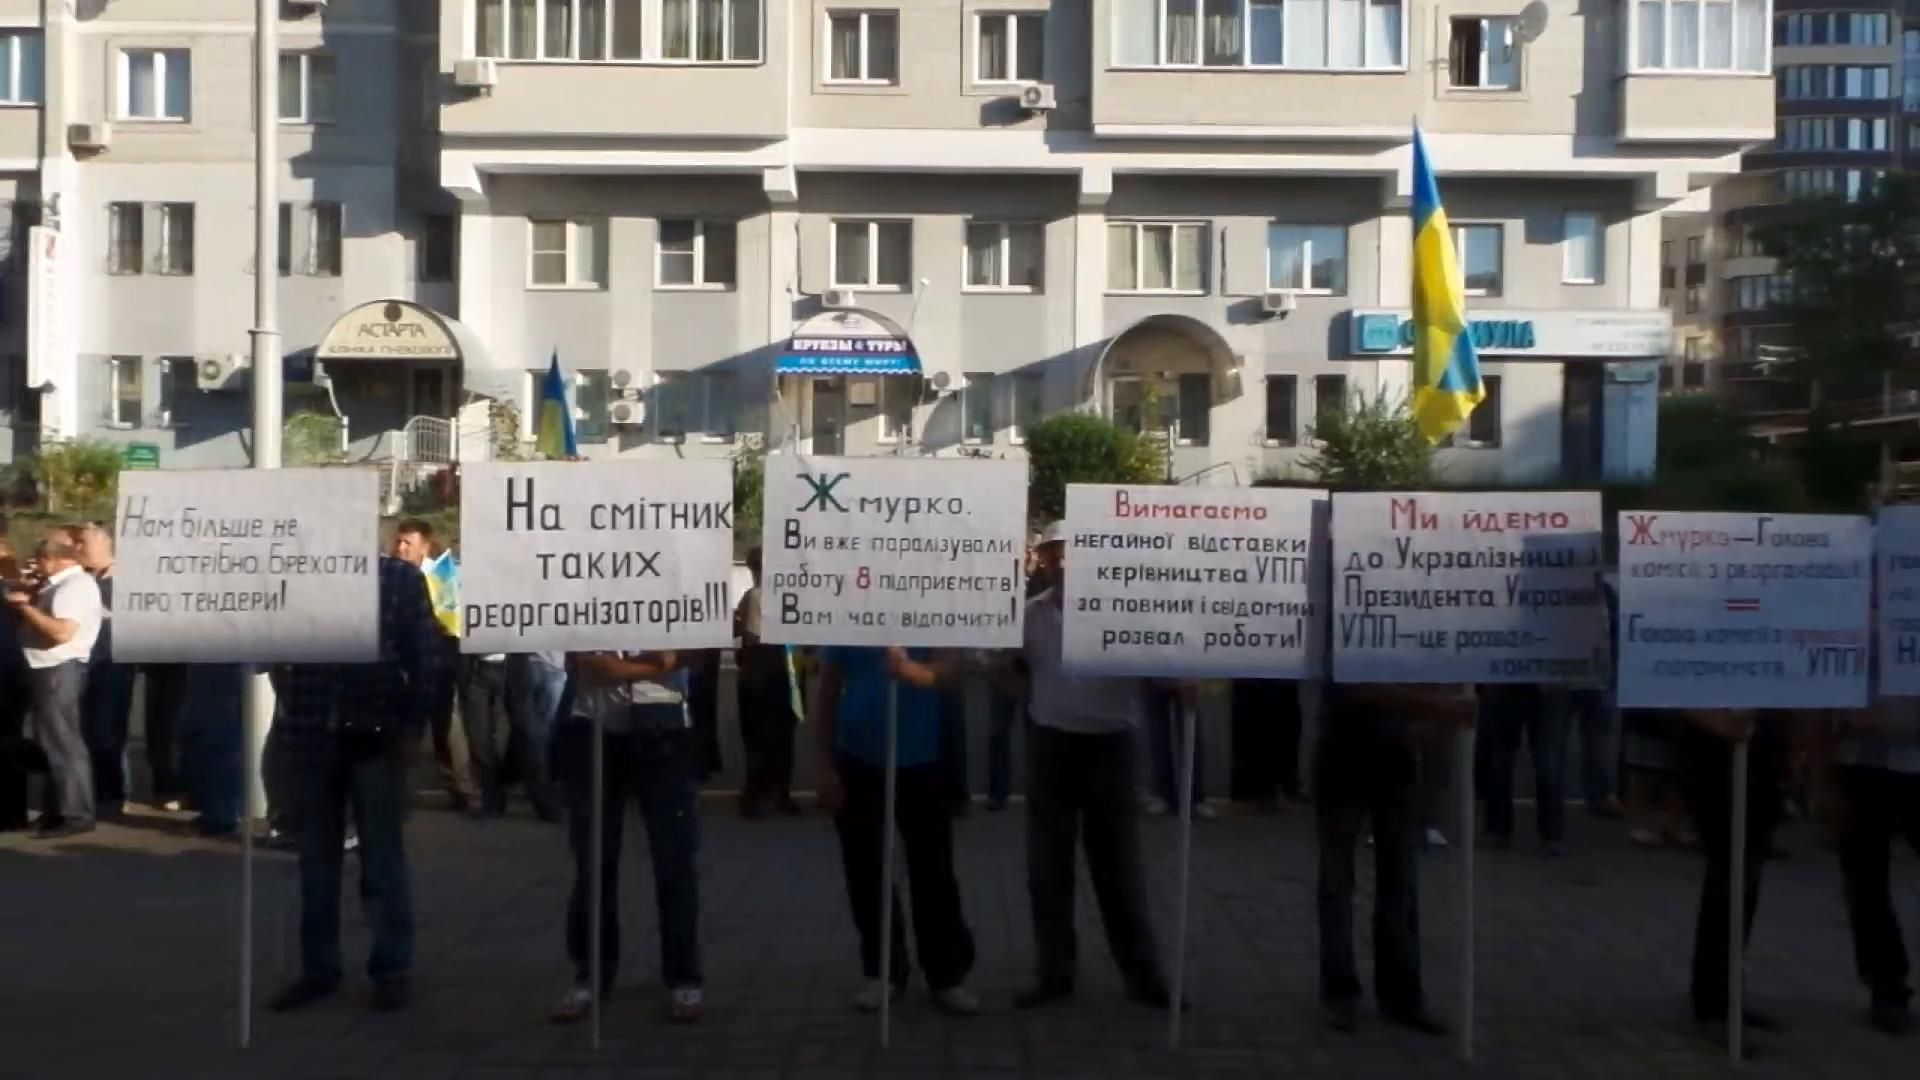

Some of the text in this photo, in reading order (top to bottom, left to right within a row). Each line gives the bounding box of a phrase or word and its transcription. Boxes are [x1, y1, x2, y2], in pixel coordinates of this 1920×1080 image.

[358, 323, 425, 337] АСТАРТА
[121, 495, 298, 538] Нам більше не
[506, 477, 733, 532] На смітник
[1115, 490, 1269, 522] Вимагаємо
[1391, 498, 1570, 533] Ми йдемо
[784, 518, 1013, 561] Ви вже паралізували
[1073, 532, 1306, 553] негайної відставки
[1344, 551, 1384, 572] до
[1395, 536, 1575, 577] Укрзалізниці
[156, 542, 369, 576] потрібно брехати
[536, 551, 662, 581] таких
[1097, 556, 1307, 588] керівництва УПП
[773, 558, 1020, 598] роботу 8 підприємств!
[1344, 574, 1496, 614] Президента
[127, 579, 288, 613] про тендери!
[464, 581, 729, 638] реорганізаторів!!!
[781, 593, 1017, 629] Вам час відпочити!
[1077, 597, 1100, 613] за
[1111, 596, 1194, 614] повний
[1200, 596, 1206, 614] і
[1102, 618, 1304, 652] розвал роботи!
